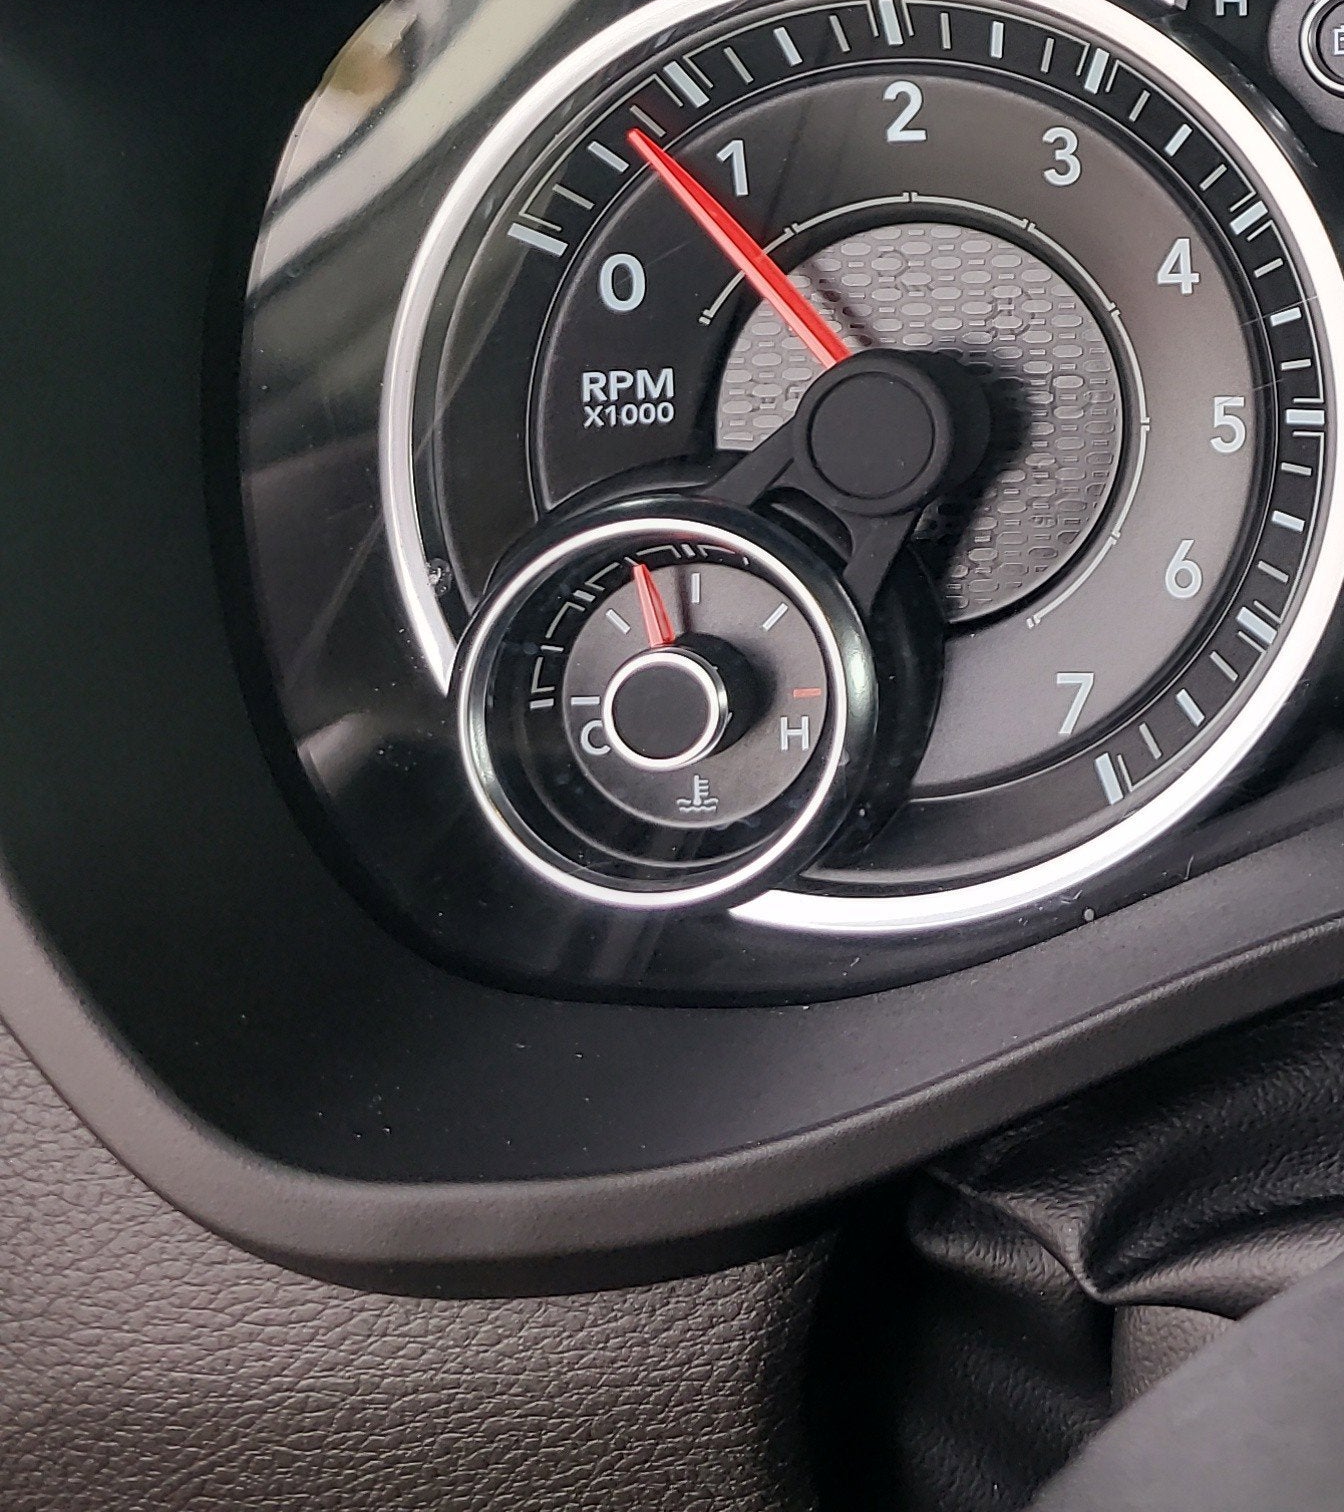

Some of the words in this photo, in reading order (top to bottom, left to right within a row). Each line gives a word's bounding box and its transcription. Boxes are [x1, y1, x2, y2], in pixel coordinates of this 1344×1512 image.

[883, 81, 926, 142] 2
[716, 140, 748, 196] 1
[1043, 127, 1080, 185] 3
[599, 254, 645, 312] 0
[1157, 239, 1199, 294] 4
[582, 368, 674, 403] RPM
[583, 401, 674, 428] X1000
[1210, 397, 1245, 453] 5
[1165, 540, 1201, 599] 6
[1053, 672, 1096, 736] 7
[580, 719, 611, 755] C
[781, 716, 809, 751] H
